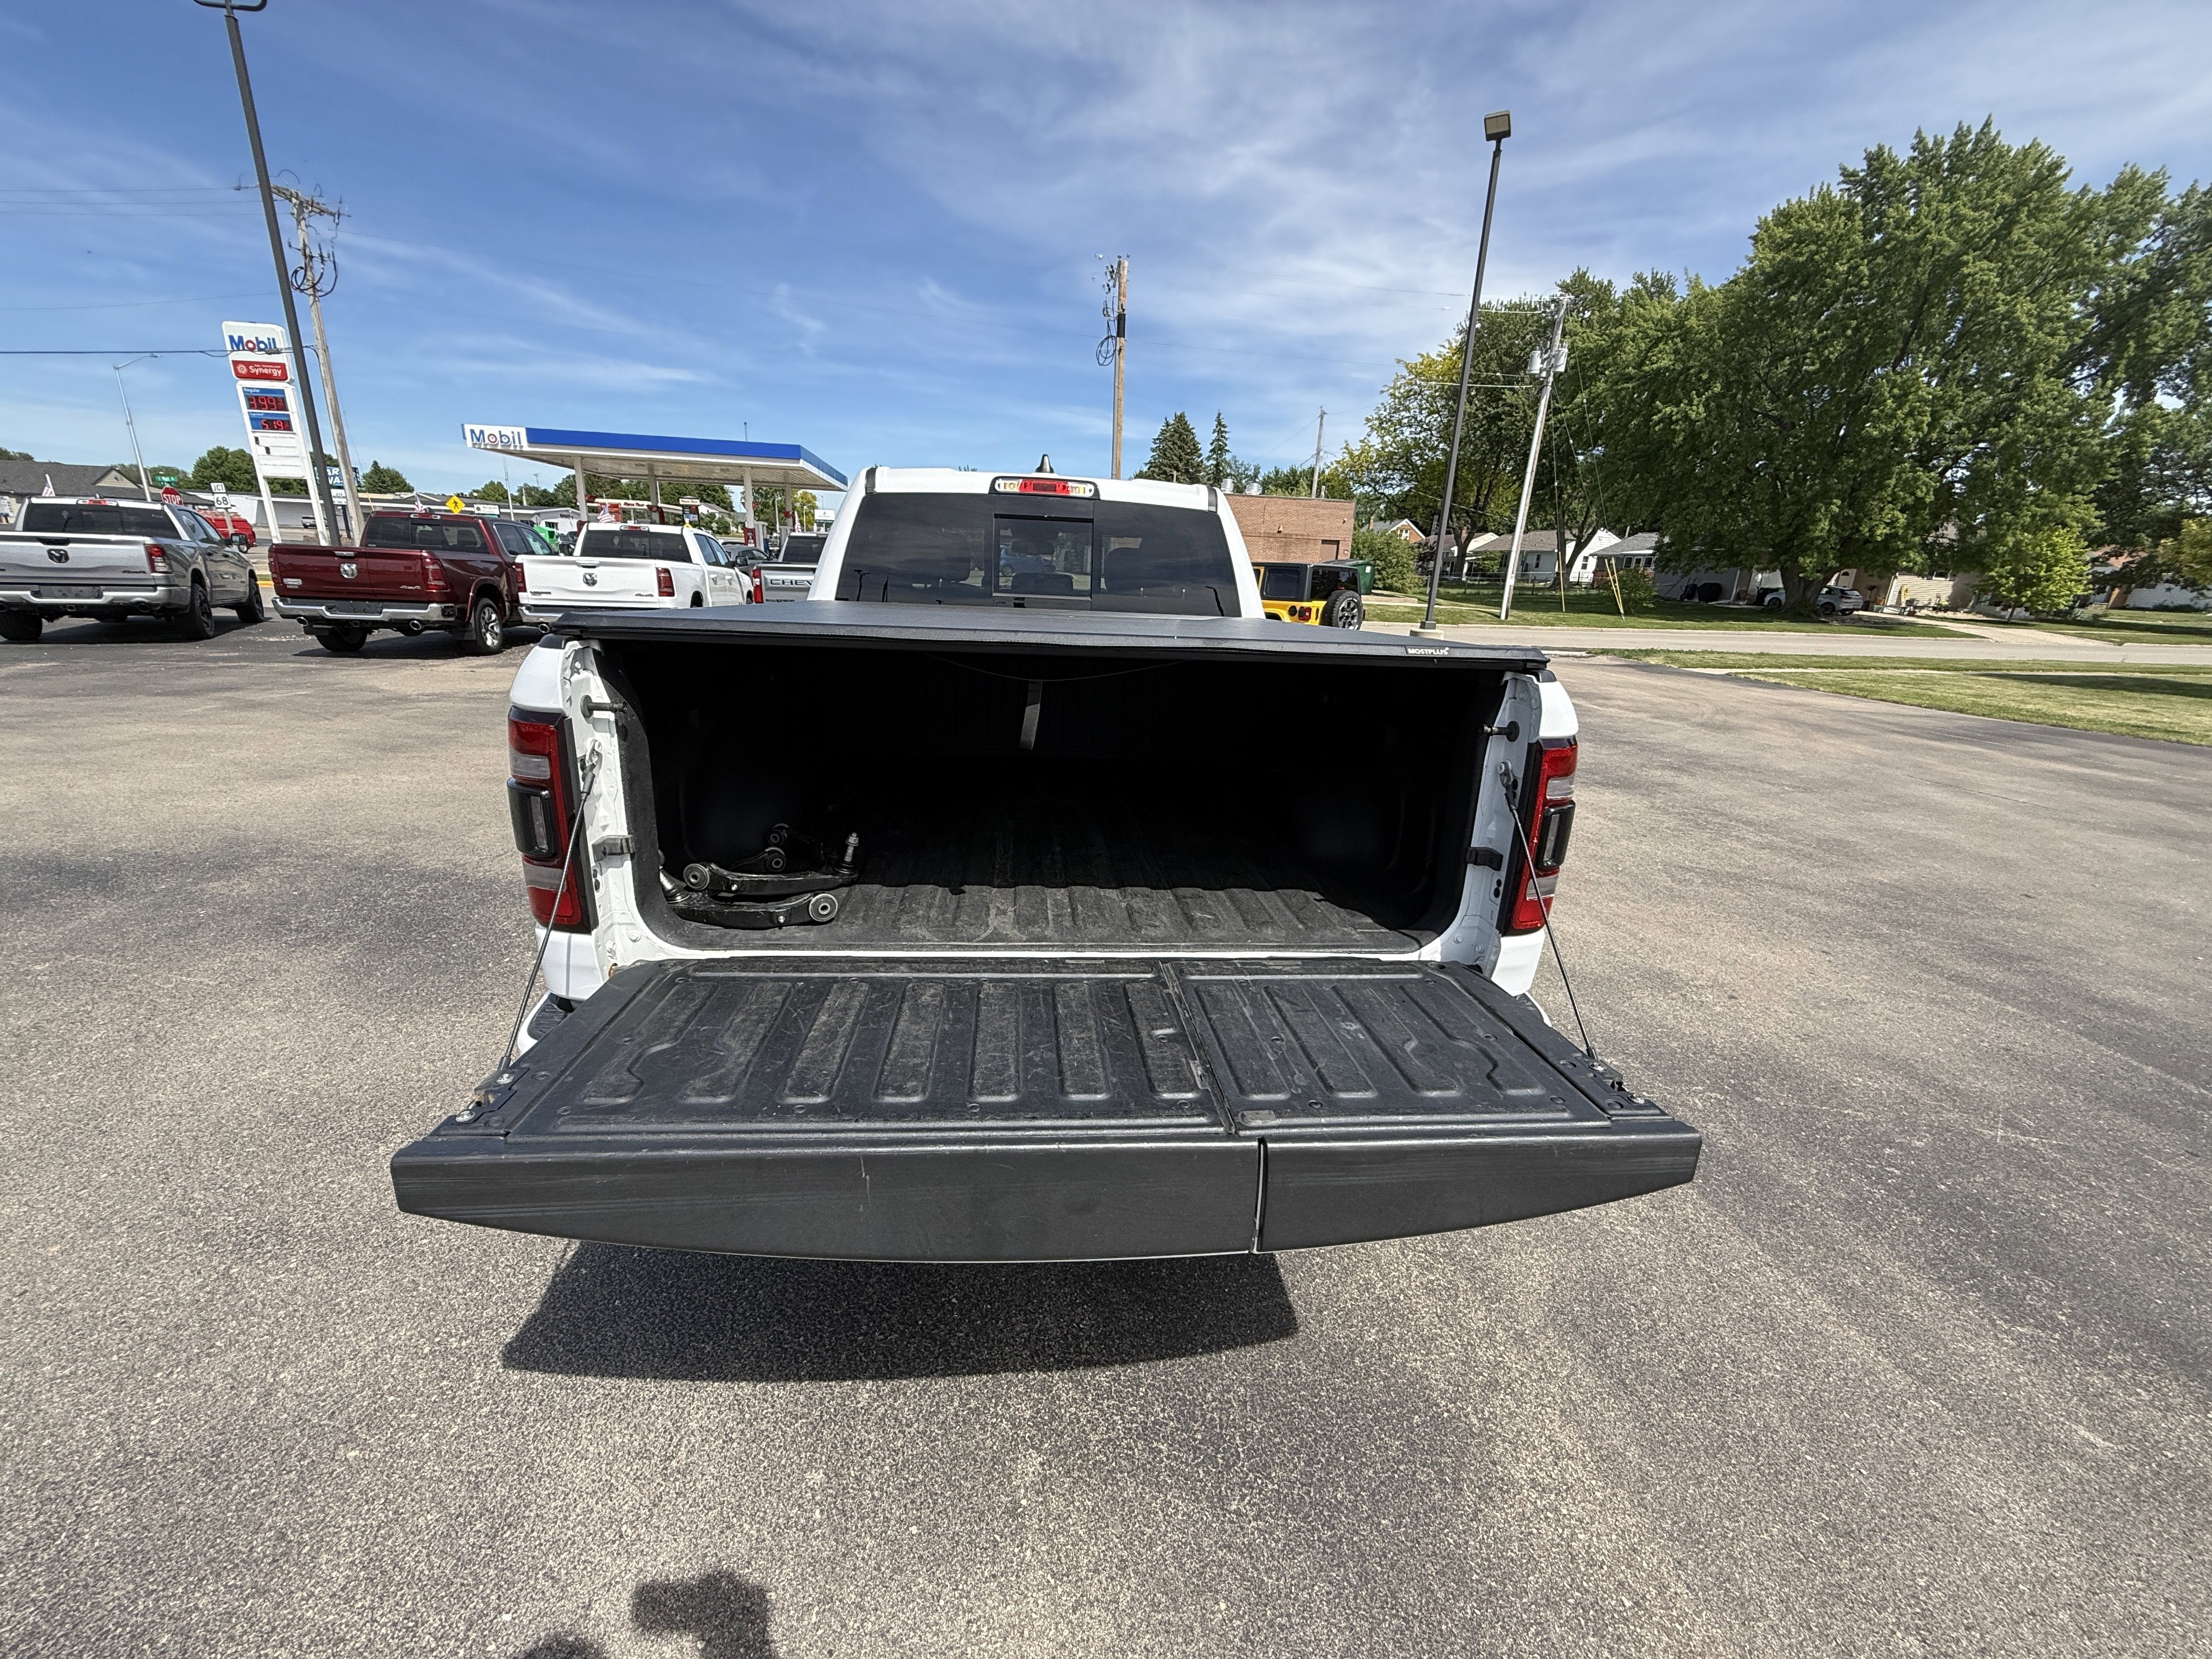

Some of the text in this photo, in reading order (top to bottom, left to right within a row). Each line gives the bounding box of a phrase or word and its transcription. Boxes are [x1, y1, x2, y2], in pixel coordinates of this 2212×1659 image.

[228, 335, 277, 352] Mobil
[249, 365, 282, 376] Synergy
[470, 428, 522, 445] Mobil
[163, 494, 181, 504] STOP
[216, 496, 229, 505] 68
